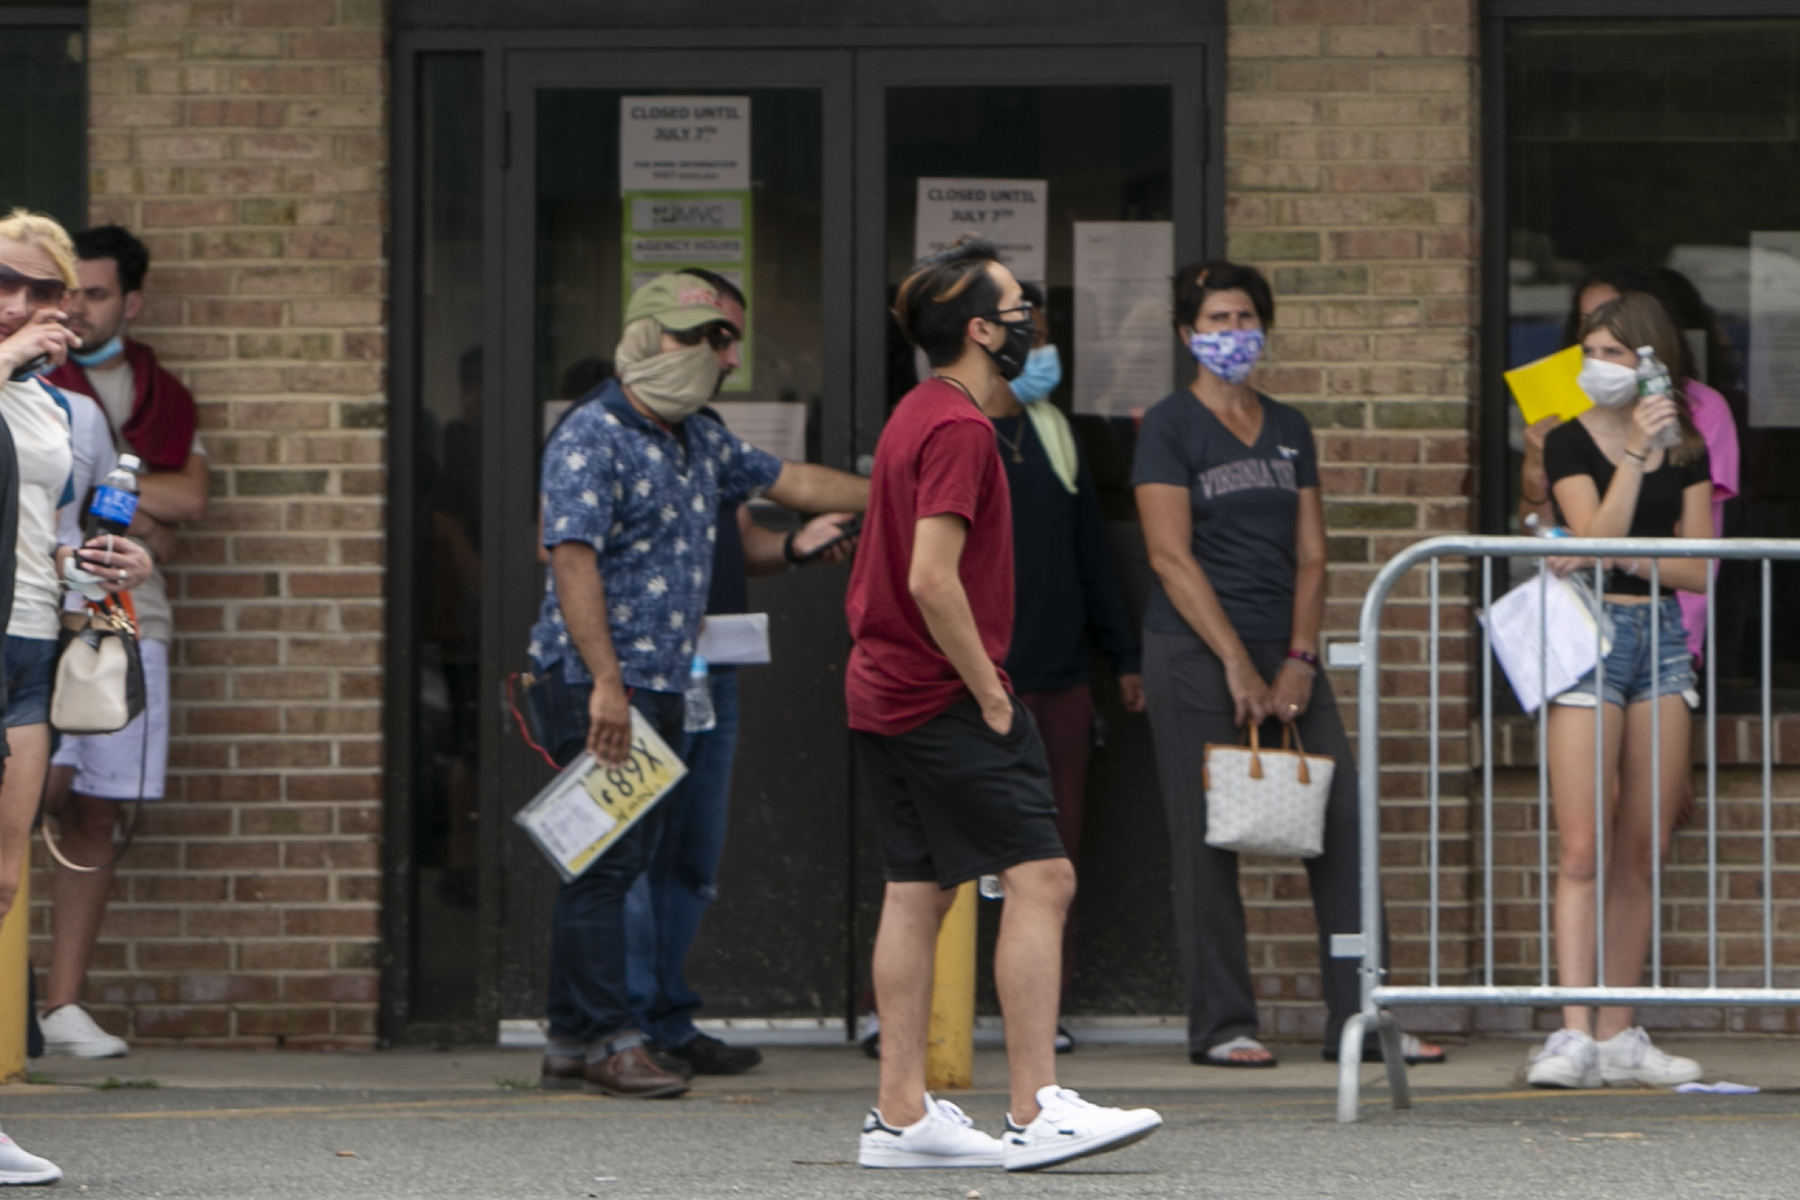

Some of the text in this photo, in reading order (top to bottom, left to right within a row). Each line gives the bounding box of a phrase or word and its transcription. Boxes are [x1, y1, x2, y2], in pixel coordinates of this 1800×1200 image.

[631, 106, 740, 120] CLOSED UNTIL
[654, 127, 691, 141] JULY
[927, 188, 1037, 202] CLOSED UNTIL
[950, 209, 986, 222] JULY
[636, 240, 741, 251] AGENCY HOURS
